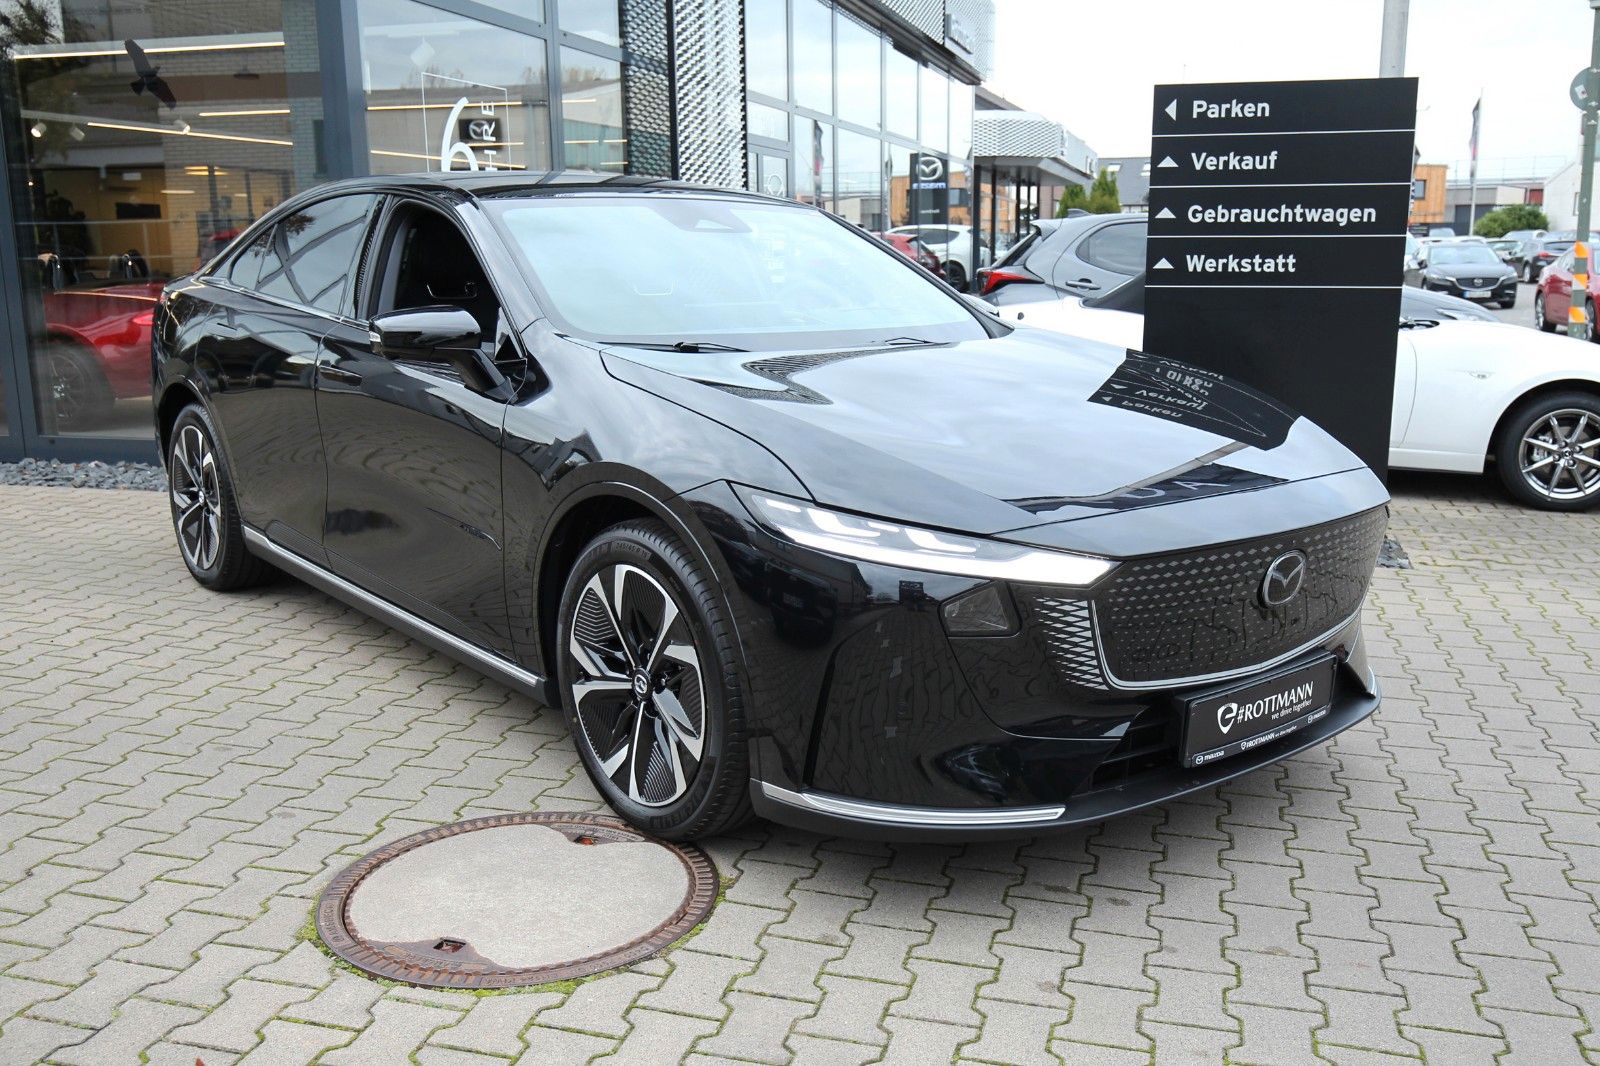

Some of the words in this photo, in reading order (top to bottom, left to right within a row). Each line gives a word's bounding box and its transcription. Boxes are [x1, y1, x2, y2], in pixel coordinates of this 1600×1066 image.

[1192, 99, 1270, 119] Parken
[481, 101, 498, 172] HRE
[1191, 151, 1278, 170] Verkauf
[1187, 204, 1376, 226] Gebrauchtwagen
[1186, 254, 1296, 273] Werkstatt
[1271, 712, 1279, 720] we
[1292, 699, 1312, 712] together
[1204, 750, 1225, 760] mazda
